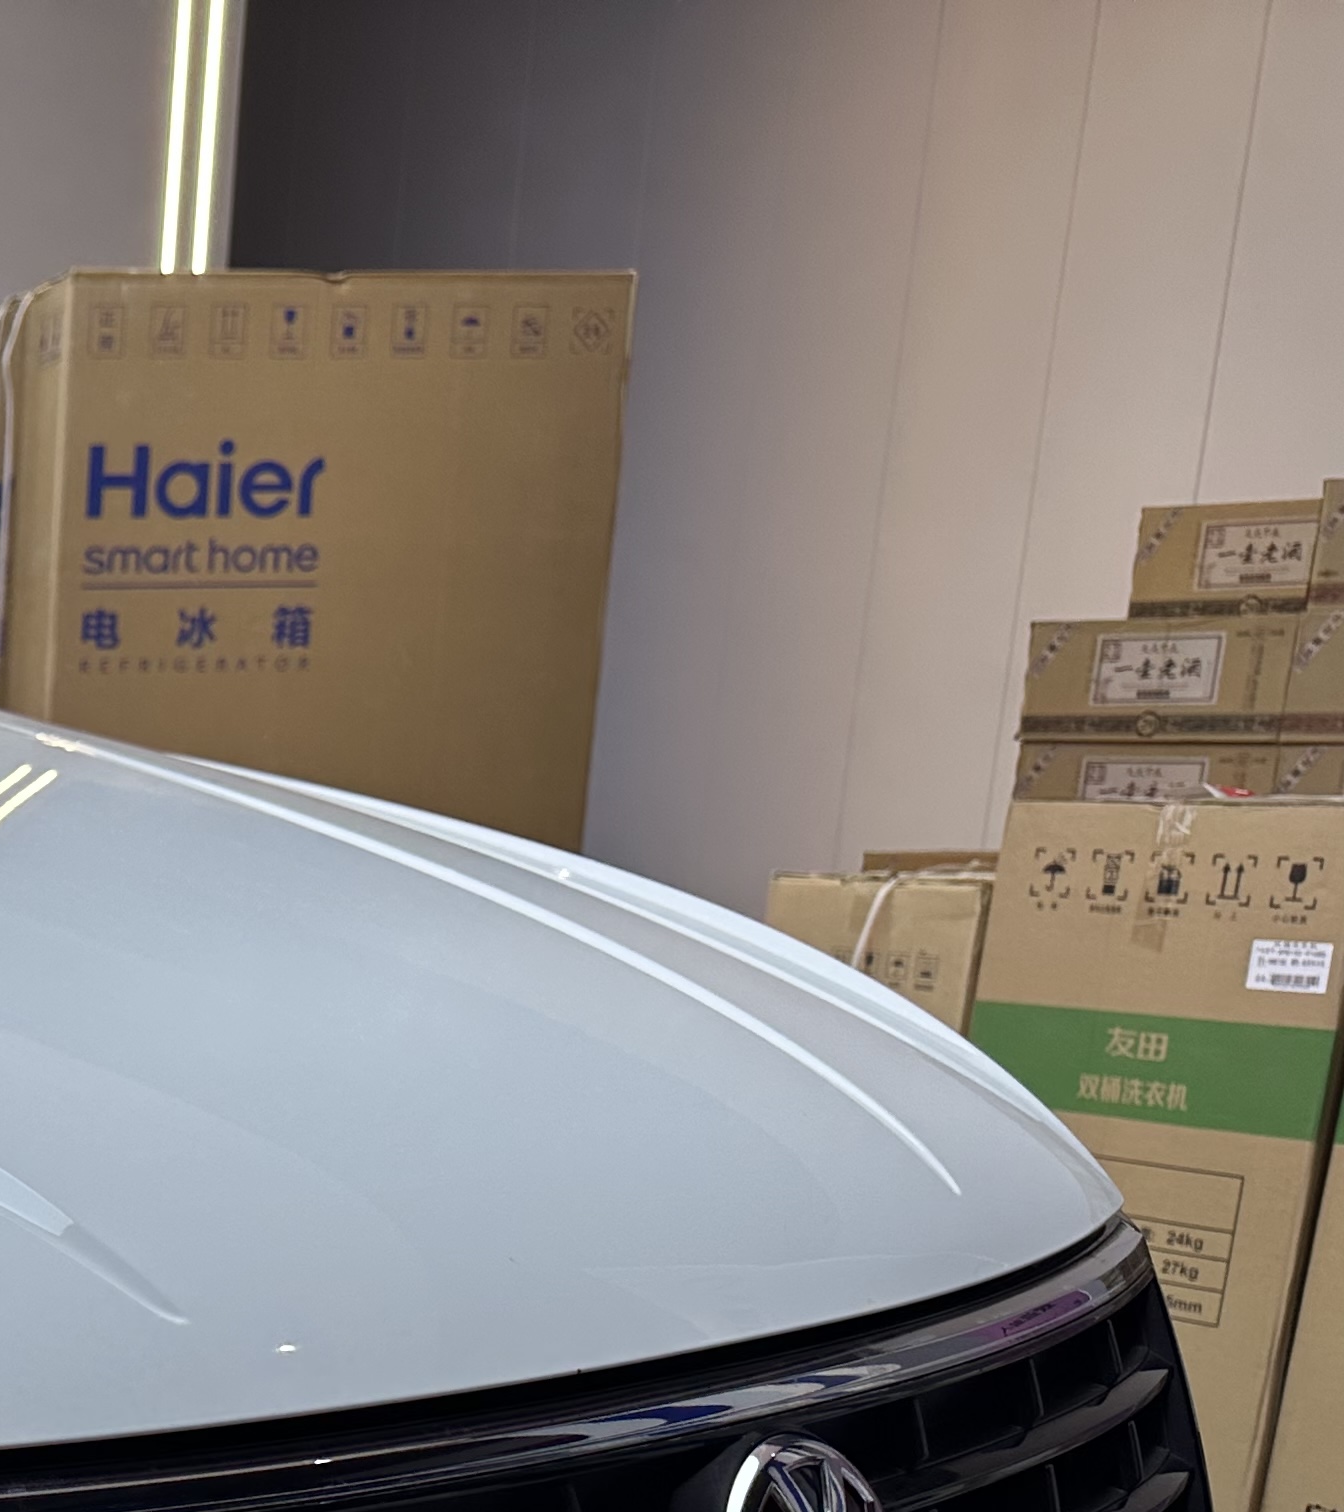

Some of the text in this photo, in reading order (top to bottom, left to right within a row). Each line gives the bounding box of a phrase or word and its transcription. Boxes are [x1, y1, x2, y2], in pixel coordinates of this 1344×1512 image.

[85, 438, 326, 519] Haier
[82, 535, 319, 576] smart home
[81, 604, 313, 651] 电冰箱
[1105, 1026, 1169, 1062] 友田
[1077, 1072, 1188, 1111] 双桶洗衣机
[1166, 1230, 1204, 1253] 24kg
[1161, 1258, 1200, 1282] 27kg
